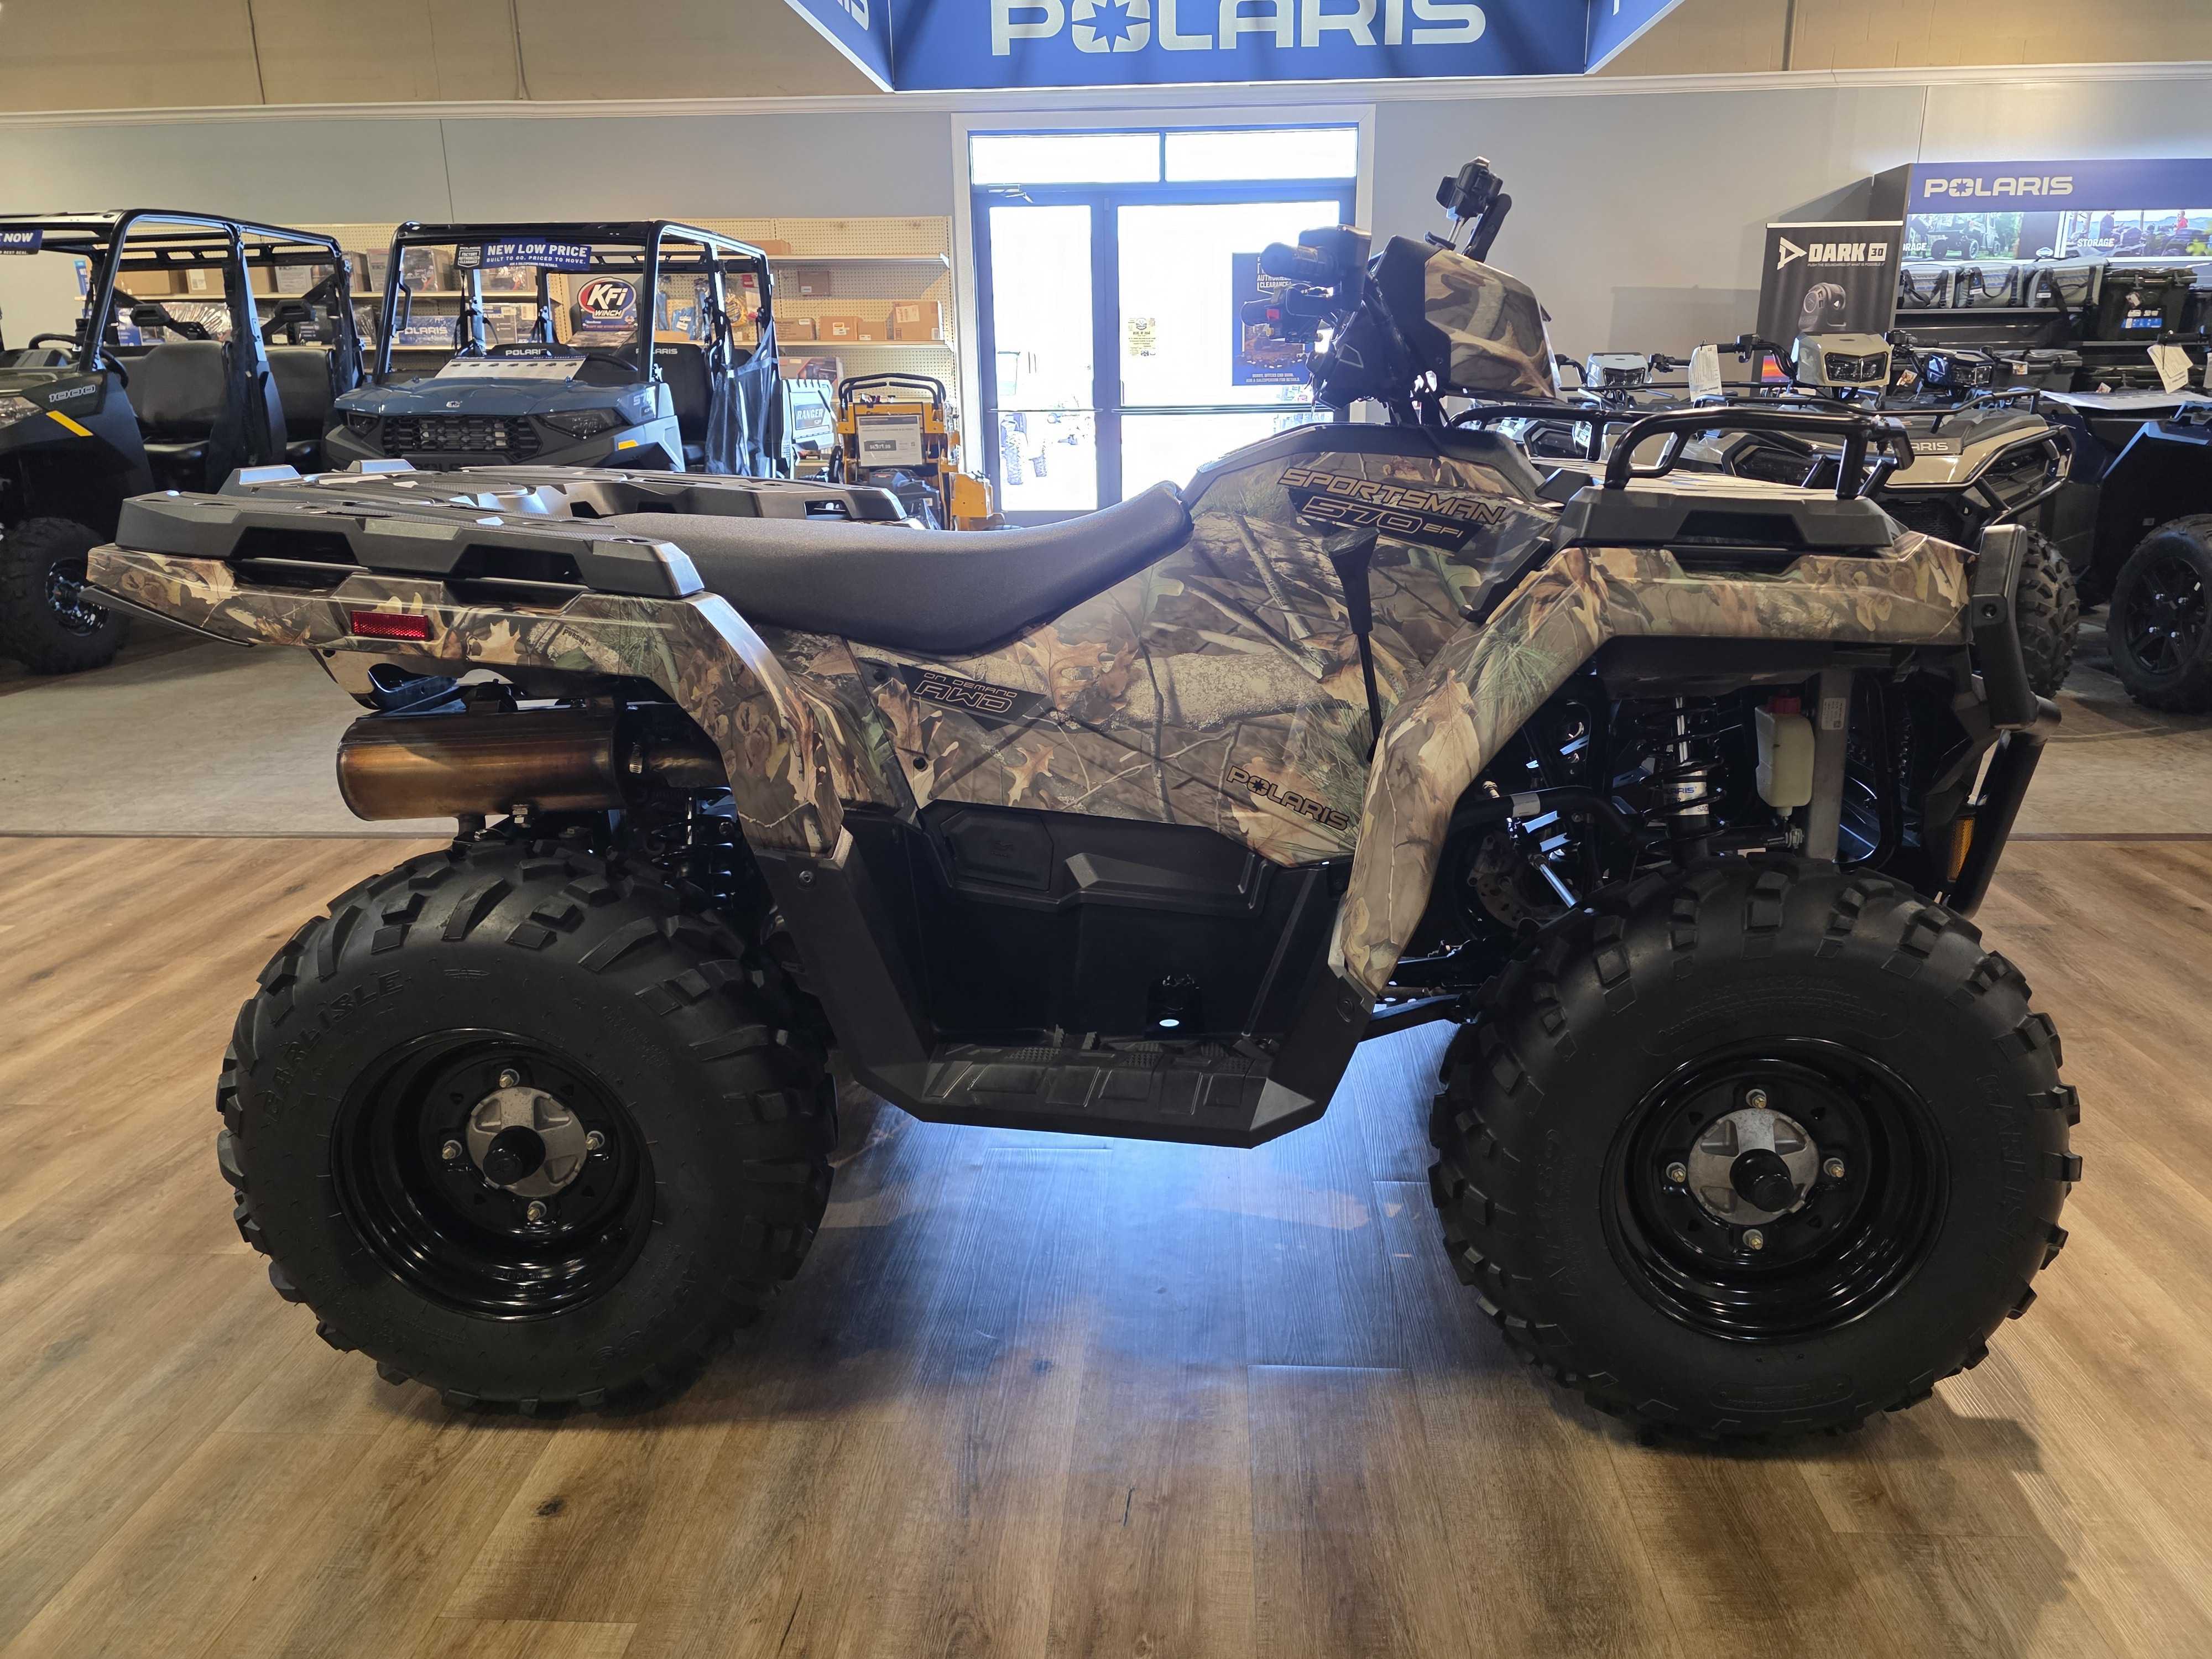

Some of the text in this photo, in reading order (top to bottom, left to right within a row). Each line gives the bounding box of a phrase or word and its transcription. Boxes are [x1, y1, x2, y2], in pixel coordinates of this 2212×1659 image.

[992, 0, 1486, 56] POLARIS
[1924, 176, 2073, 198] POLARIS
[3, 233, 34, 243] NOW
[2077, 238, 2115, 248] STORAGE
[487, 244, 587, 257] NEW LOW PRICE
[1808, 243, 1866, 262] DARK
[49, 385, 96, 403] 1000
[797, 408, 823, 420] RANGER
[1911, 442, 1949, 451] ARIS
[1277, 467, 1505, 525] SPORTSMAN
[1302, 496, 1463, 538] 570 EFI
[924, 672, 1018, 698] ON DEMAND
[914, 680, 1013, 713] AWD
[1226, 765, 1350, 831] POLARIS
